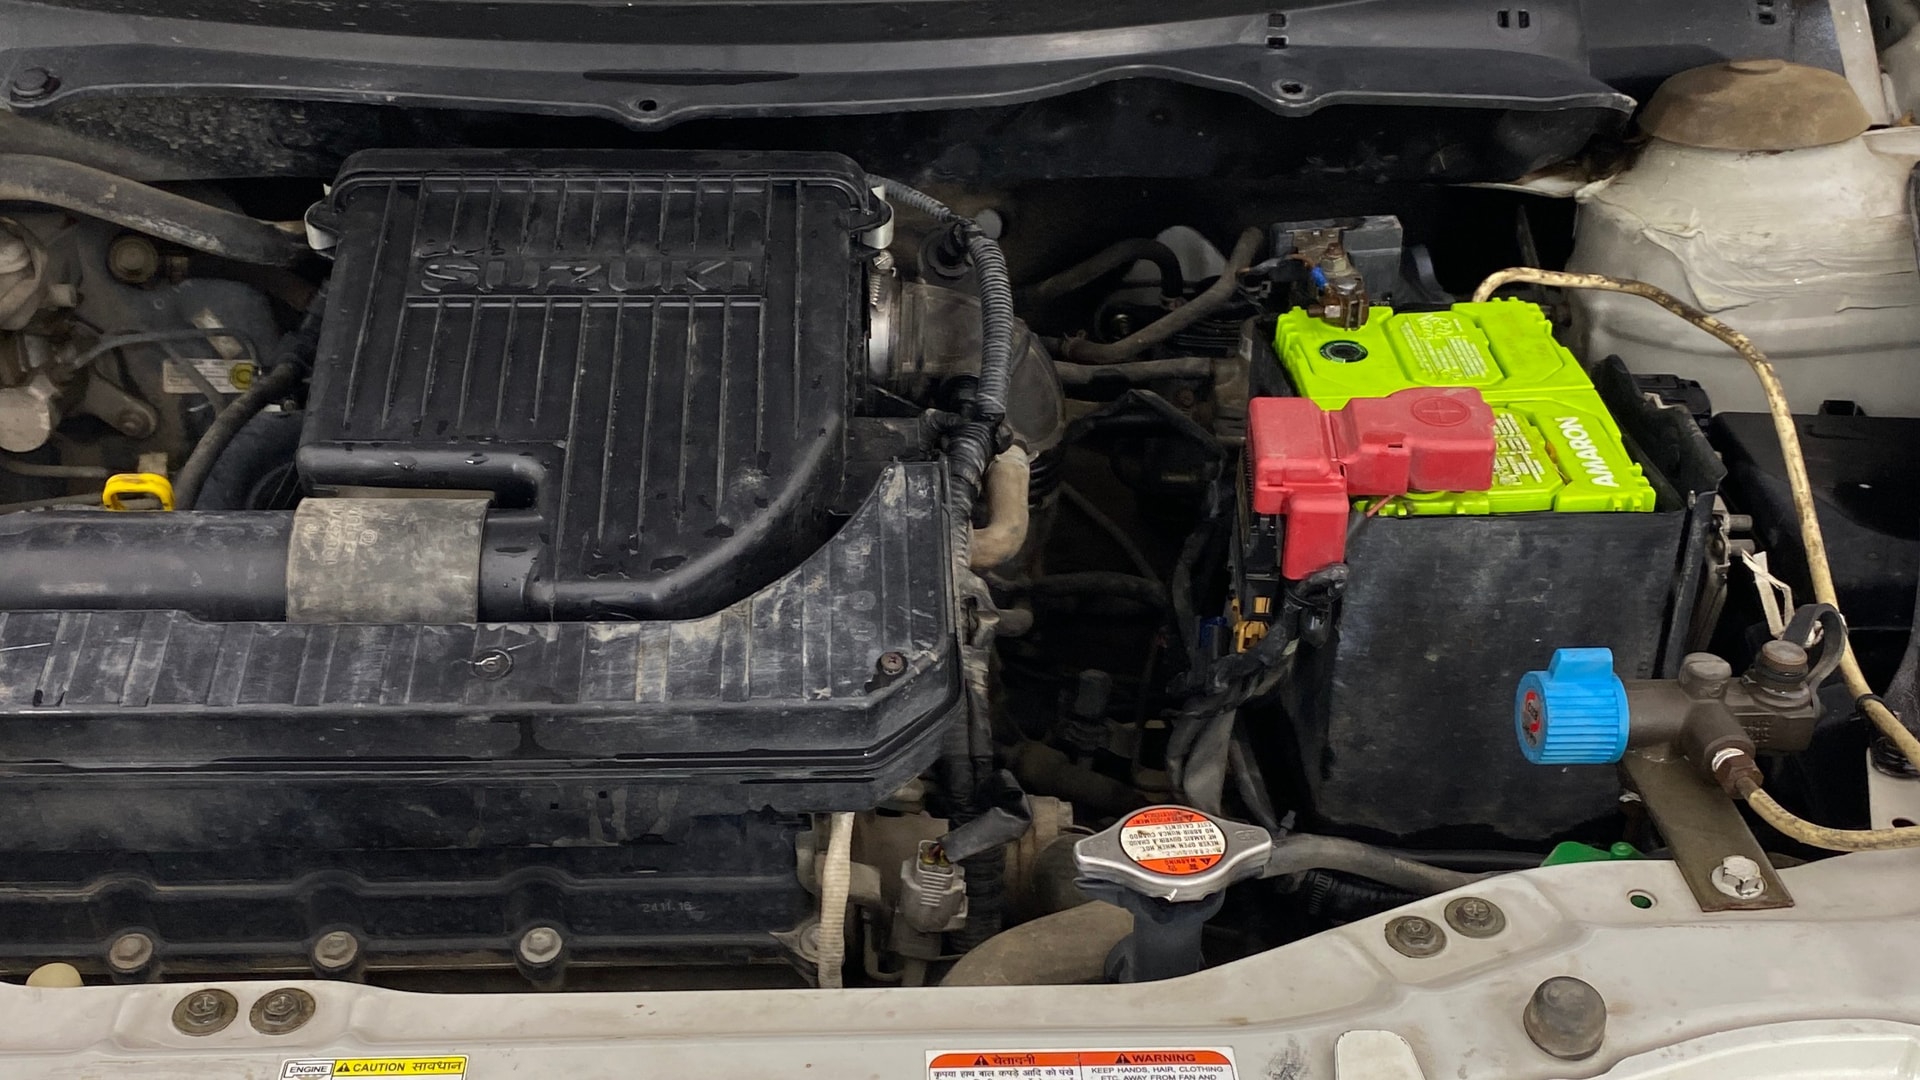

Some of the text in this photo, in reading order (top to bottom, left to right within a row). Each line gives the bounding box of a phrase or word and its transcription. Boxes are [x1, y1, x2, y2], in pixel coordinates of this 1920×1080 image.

[421, 259, 751, 293] SUZUKI
[1554, 416, 1620, 488] AMARON
[1164, 857, 1197, 865] WARNING
[1132, 1053, 1196, 1063] WARNING
[353, 1062, 406, 1072] CAUTION
[412, 1061, 463, 1071] सावधान
[1117, 1066, 1150, 1074] HANDS,
[1153, 1066, 1177, 1074] HAIR,
[1022, 1068, 1041, 1077] आदि
[1045, 1068, 1057, 1076] को
